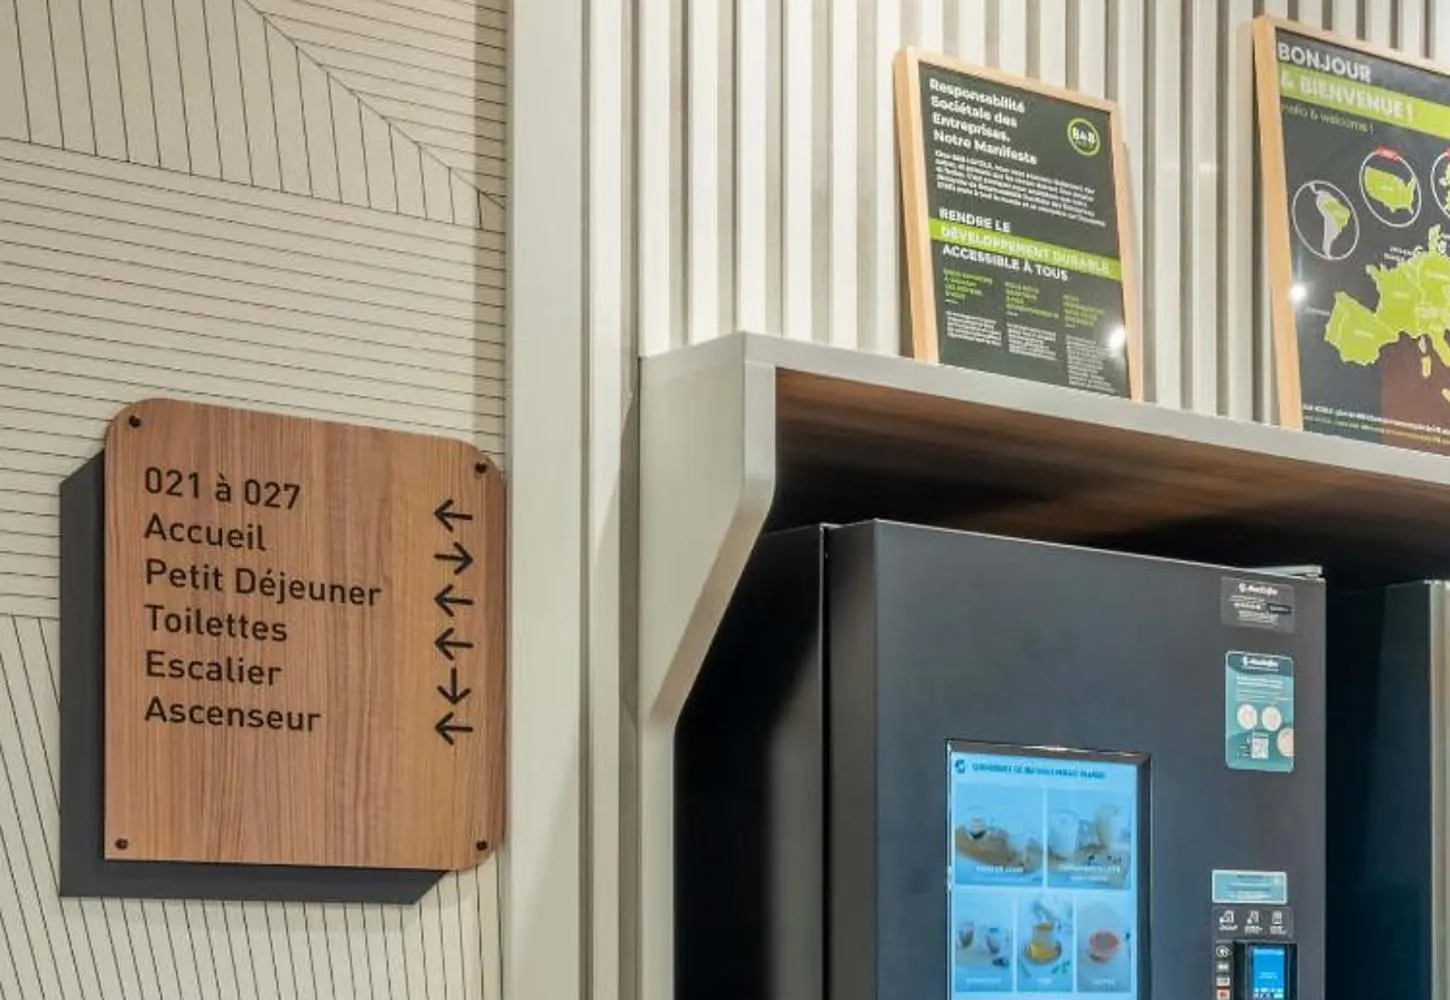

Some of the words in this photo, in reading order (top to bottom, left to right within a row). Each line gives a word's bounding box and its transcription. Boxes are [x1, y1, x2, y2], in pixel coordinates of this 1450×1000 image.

[1278, 42, 1372, 84] BONJOUR
[929, 77, 1025, 113] Responsabilité
[931, 95, 992, 121] Sociétale
[994, 111, 1018, 128] des
[1300, 75, 1404, 119] BIENVENUE
[933, 129, 972, 149] Notre
[974, 139, 1037, 165] Manifeste
[939, 208, 992, 230] RENDRE
[995, 219, 1011, 233] LE
[943, 244, 1020, 272] ACCESSIBLE
[1035, 264, 1069, 281] TOUS
[1052, 251, 1110, 274] DURABLE
[145, 467, 200, 499] 021
[215, 473, 231, 502] à
[244, 479, 301, 510] 027
[144, 513, 266, 552] Accueil
[146, 558, 224, 592] Petit
[235, 567, 383, 606] Déjeuner
[144, 604, 288, 642] Toilettes
[146, 650, 283, 686] Escalier
[144, 696, 322, 732] Ascenseur
